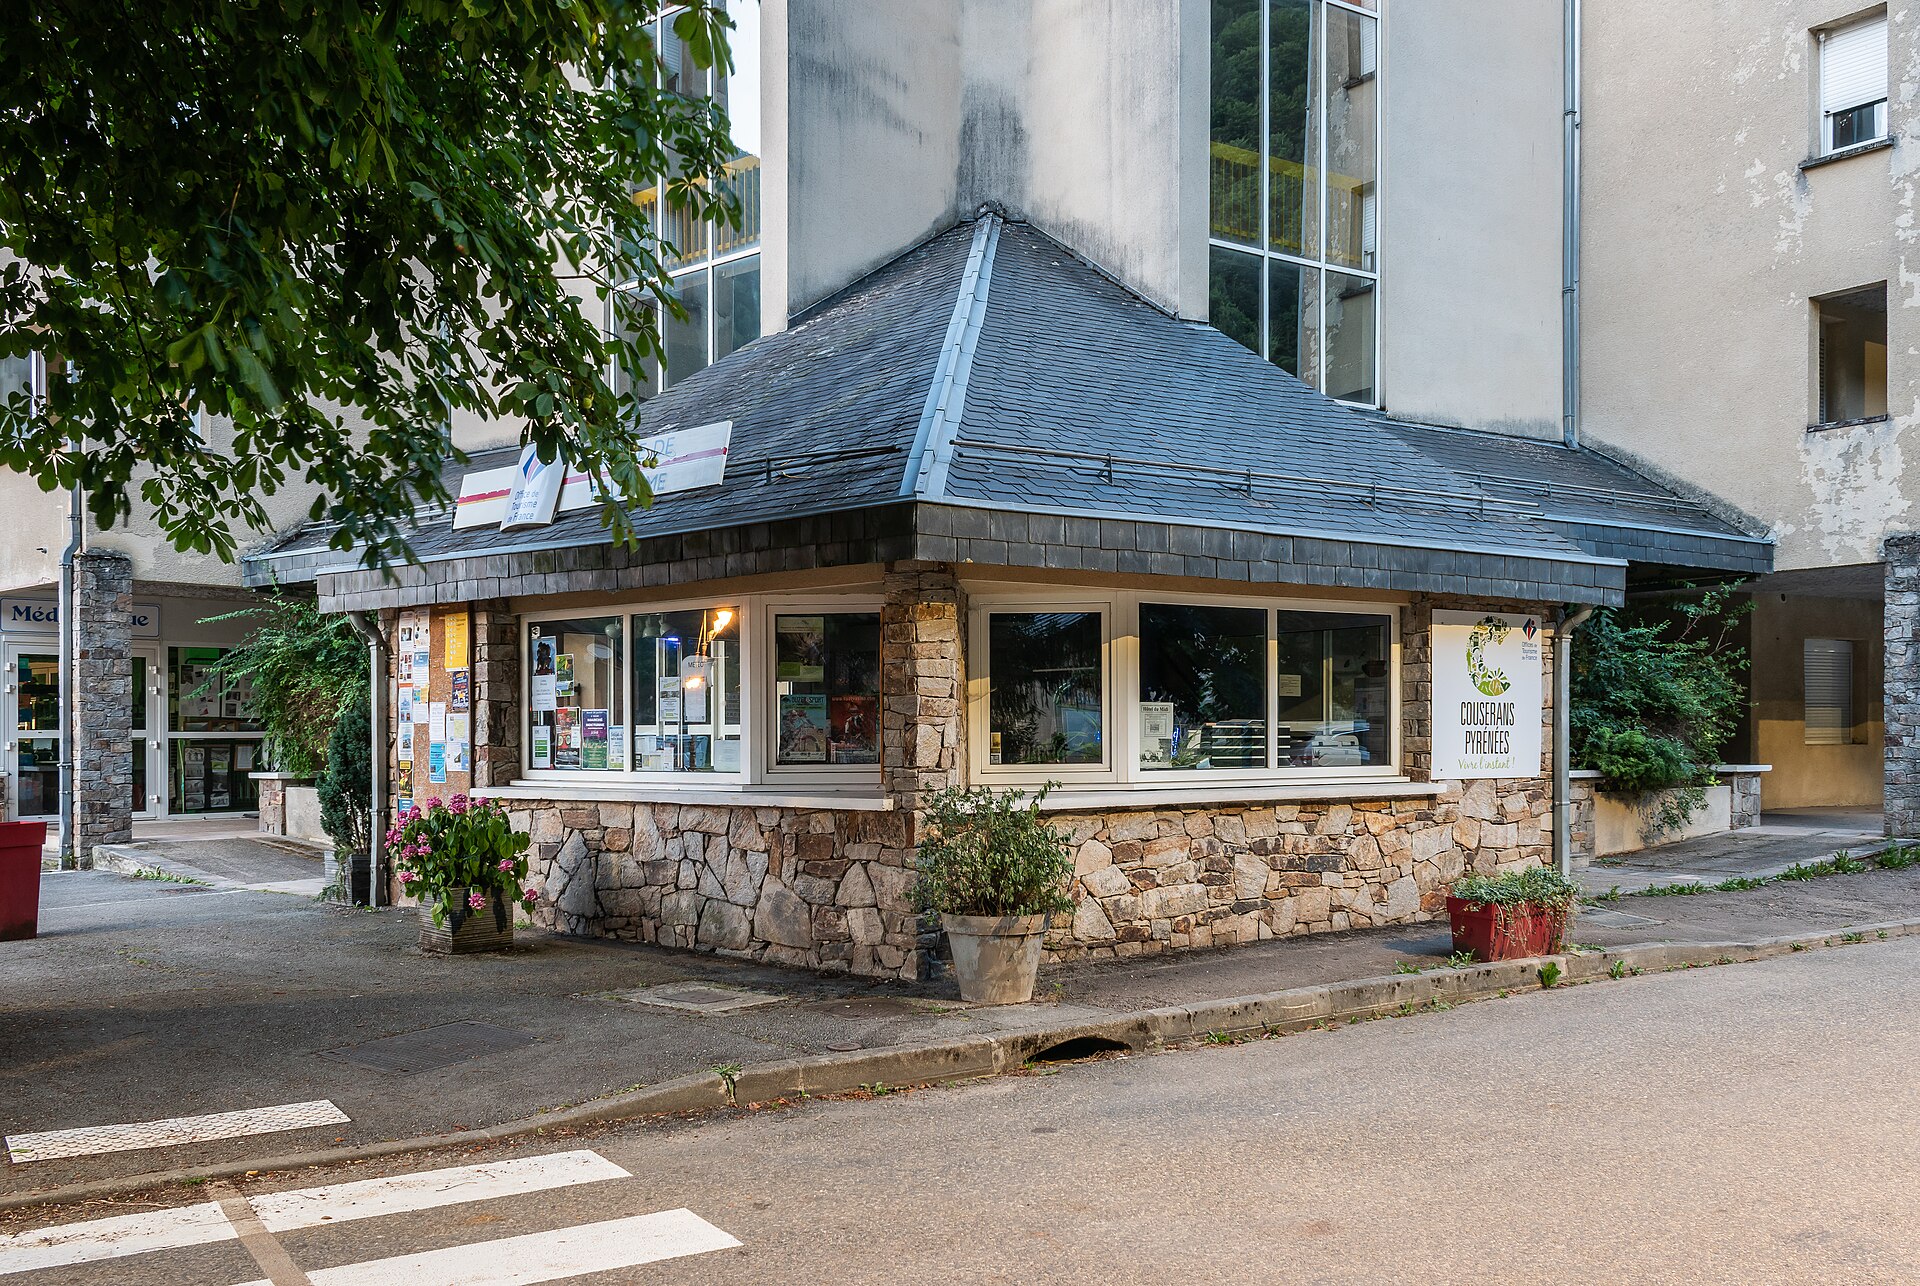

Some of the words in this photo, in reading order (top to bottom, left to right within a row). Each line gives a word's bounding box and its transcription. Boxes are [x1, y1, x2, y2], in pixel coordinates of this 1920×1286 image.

[654, 436, 676, 455] DE
[511, 500, 538, 511] Tourisme
[512, 511, 535, 522] France
[1460, 701, 1515, 726] COUSERANS
[1465, 727, 1510, 755] PYRÉNÉES
[1458, 758, 1480, 770] Vivre
